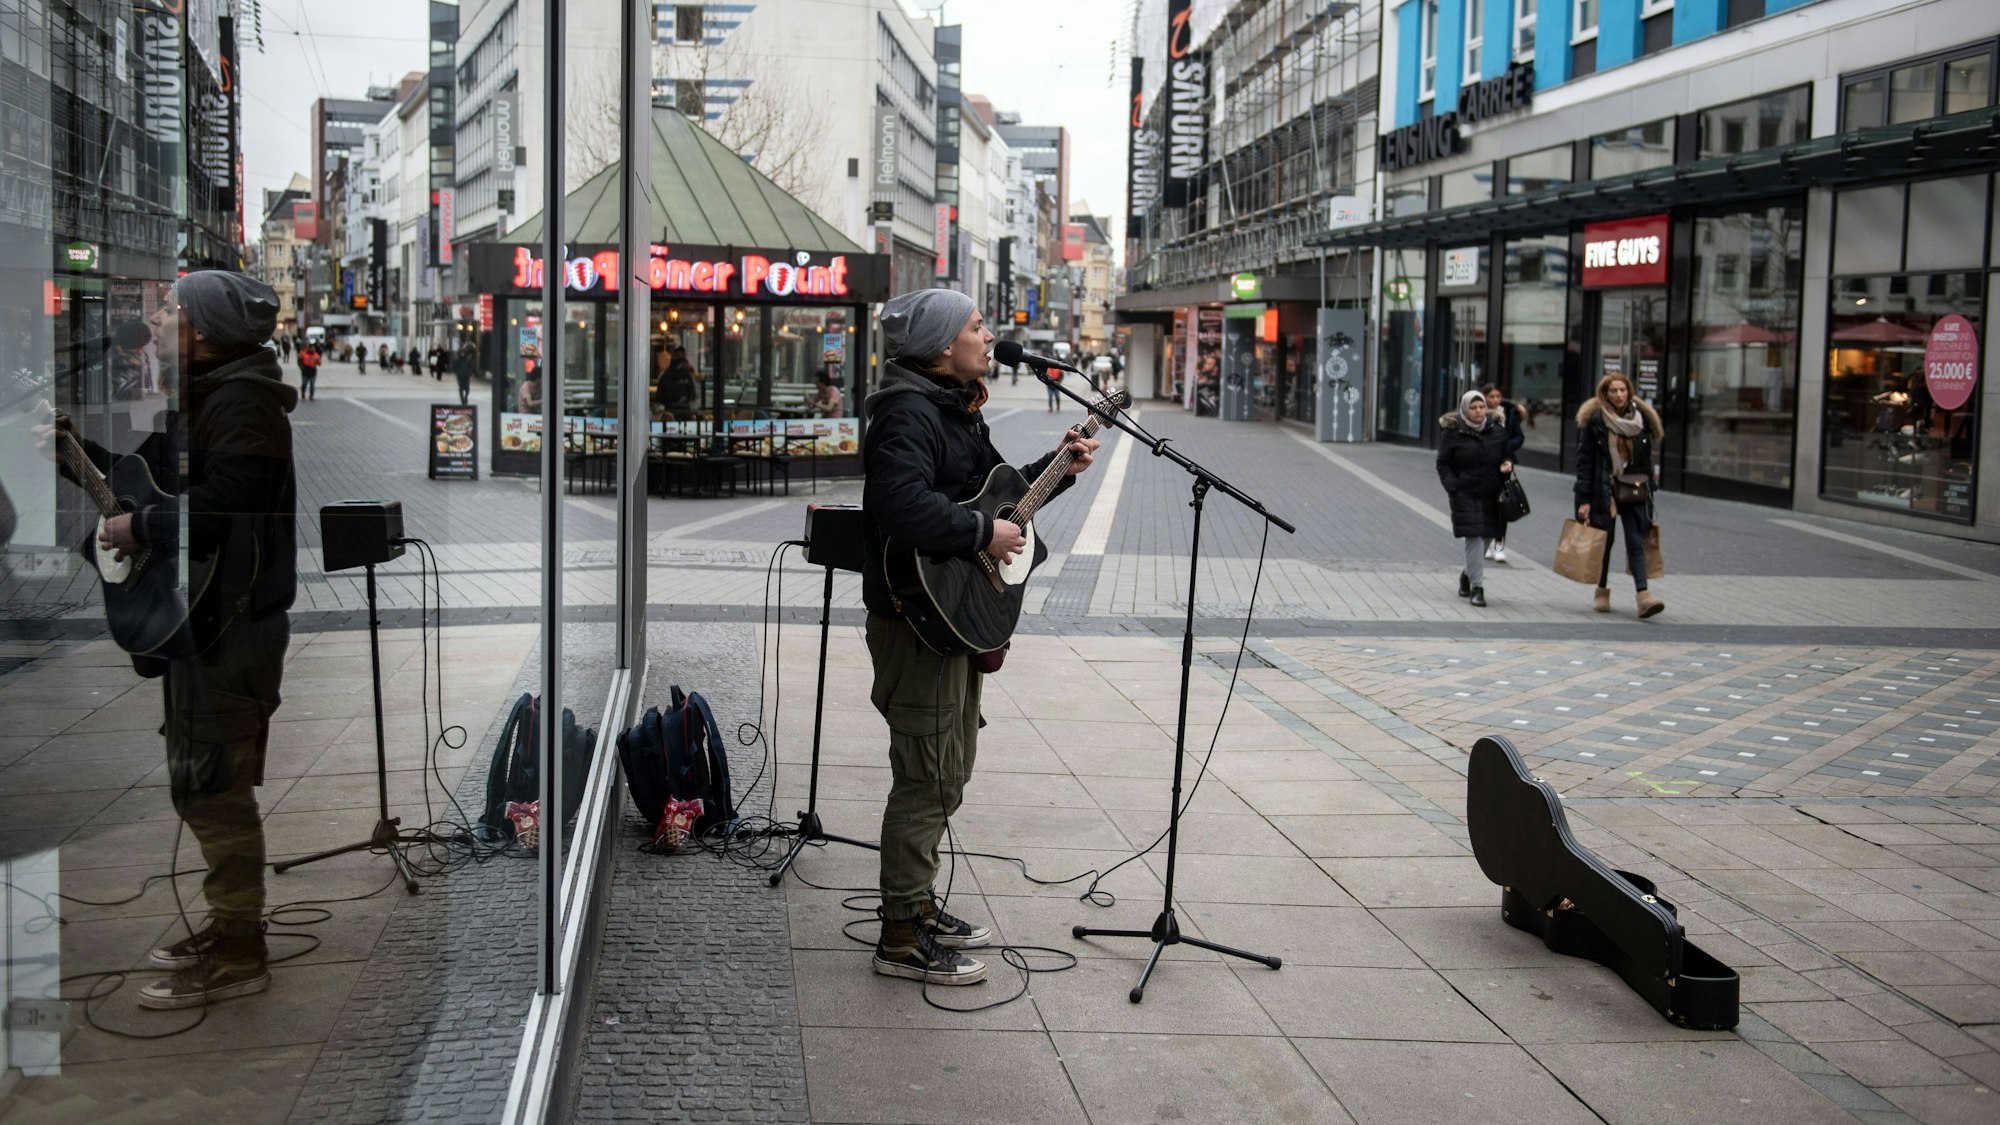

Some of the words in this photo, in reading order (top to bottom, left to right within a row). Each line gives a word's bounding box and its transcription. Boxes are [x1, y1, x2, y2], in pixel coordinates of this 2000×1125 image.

[1171, 61, 1205, 179] SATURN
[1379, 112, 1453, 172] LENSING
[1132, 128, 1160, 216] SATURN
[742, 251, 848, 296] Point
[1584, 239, 1617, 268] FIVE
[1617, 235, 1660, 266] GUYS
[1929, 362, 1964, 379] 25.000
[1966, 363, 1973, 380] €
